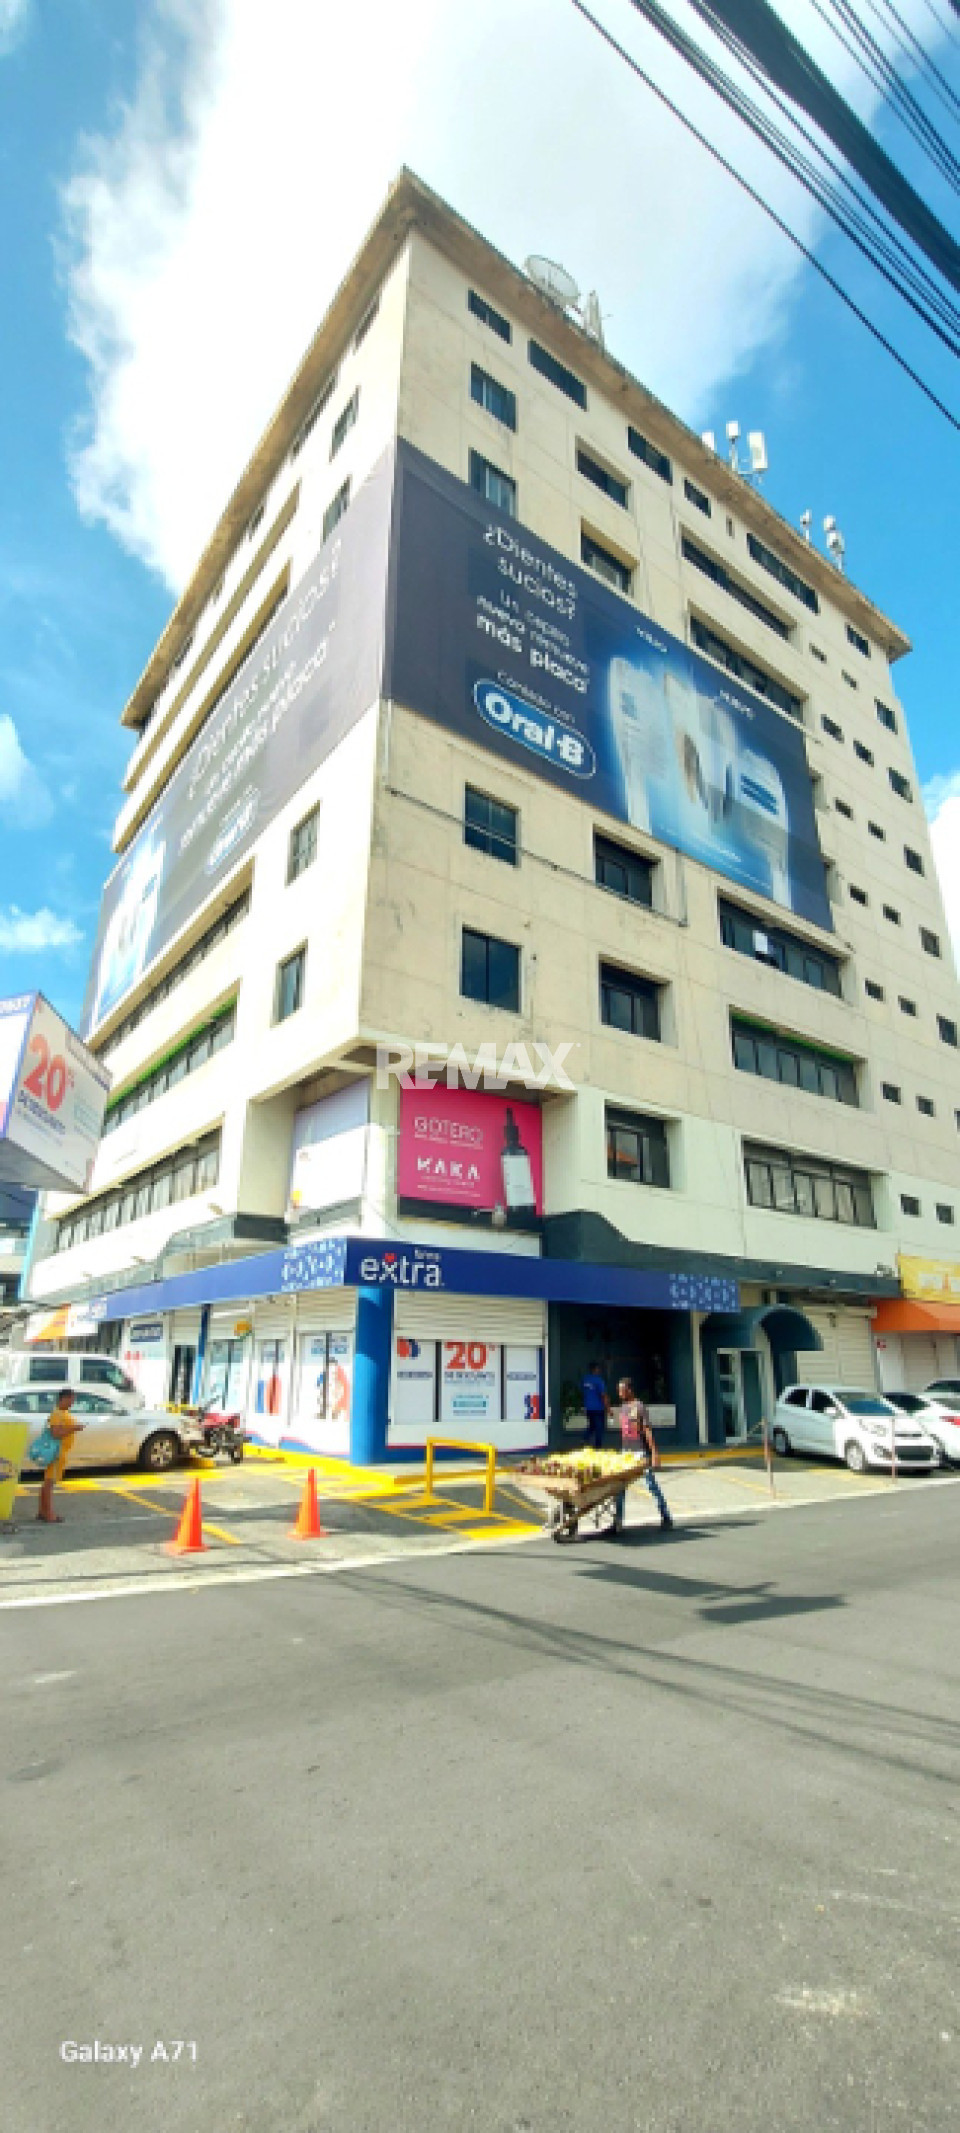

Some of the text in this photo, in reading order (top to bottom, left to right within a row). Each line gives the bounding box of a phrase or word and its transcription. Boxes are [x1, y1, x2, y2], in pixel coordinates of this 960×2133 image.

[483, 524, 578, 599] ¿Dientes
[498, 557, 575, 620] sucios?
[477, 613, 522, 653] más
[485, 692, 584, 767] Oral-B
[360, 1255, 441, 1287] extra
